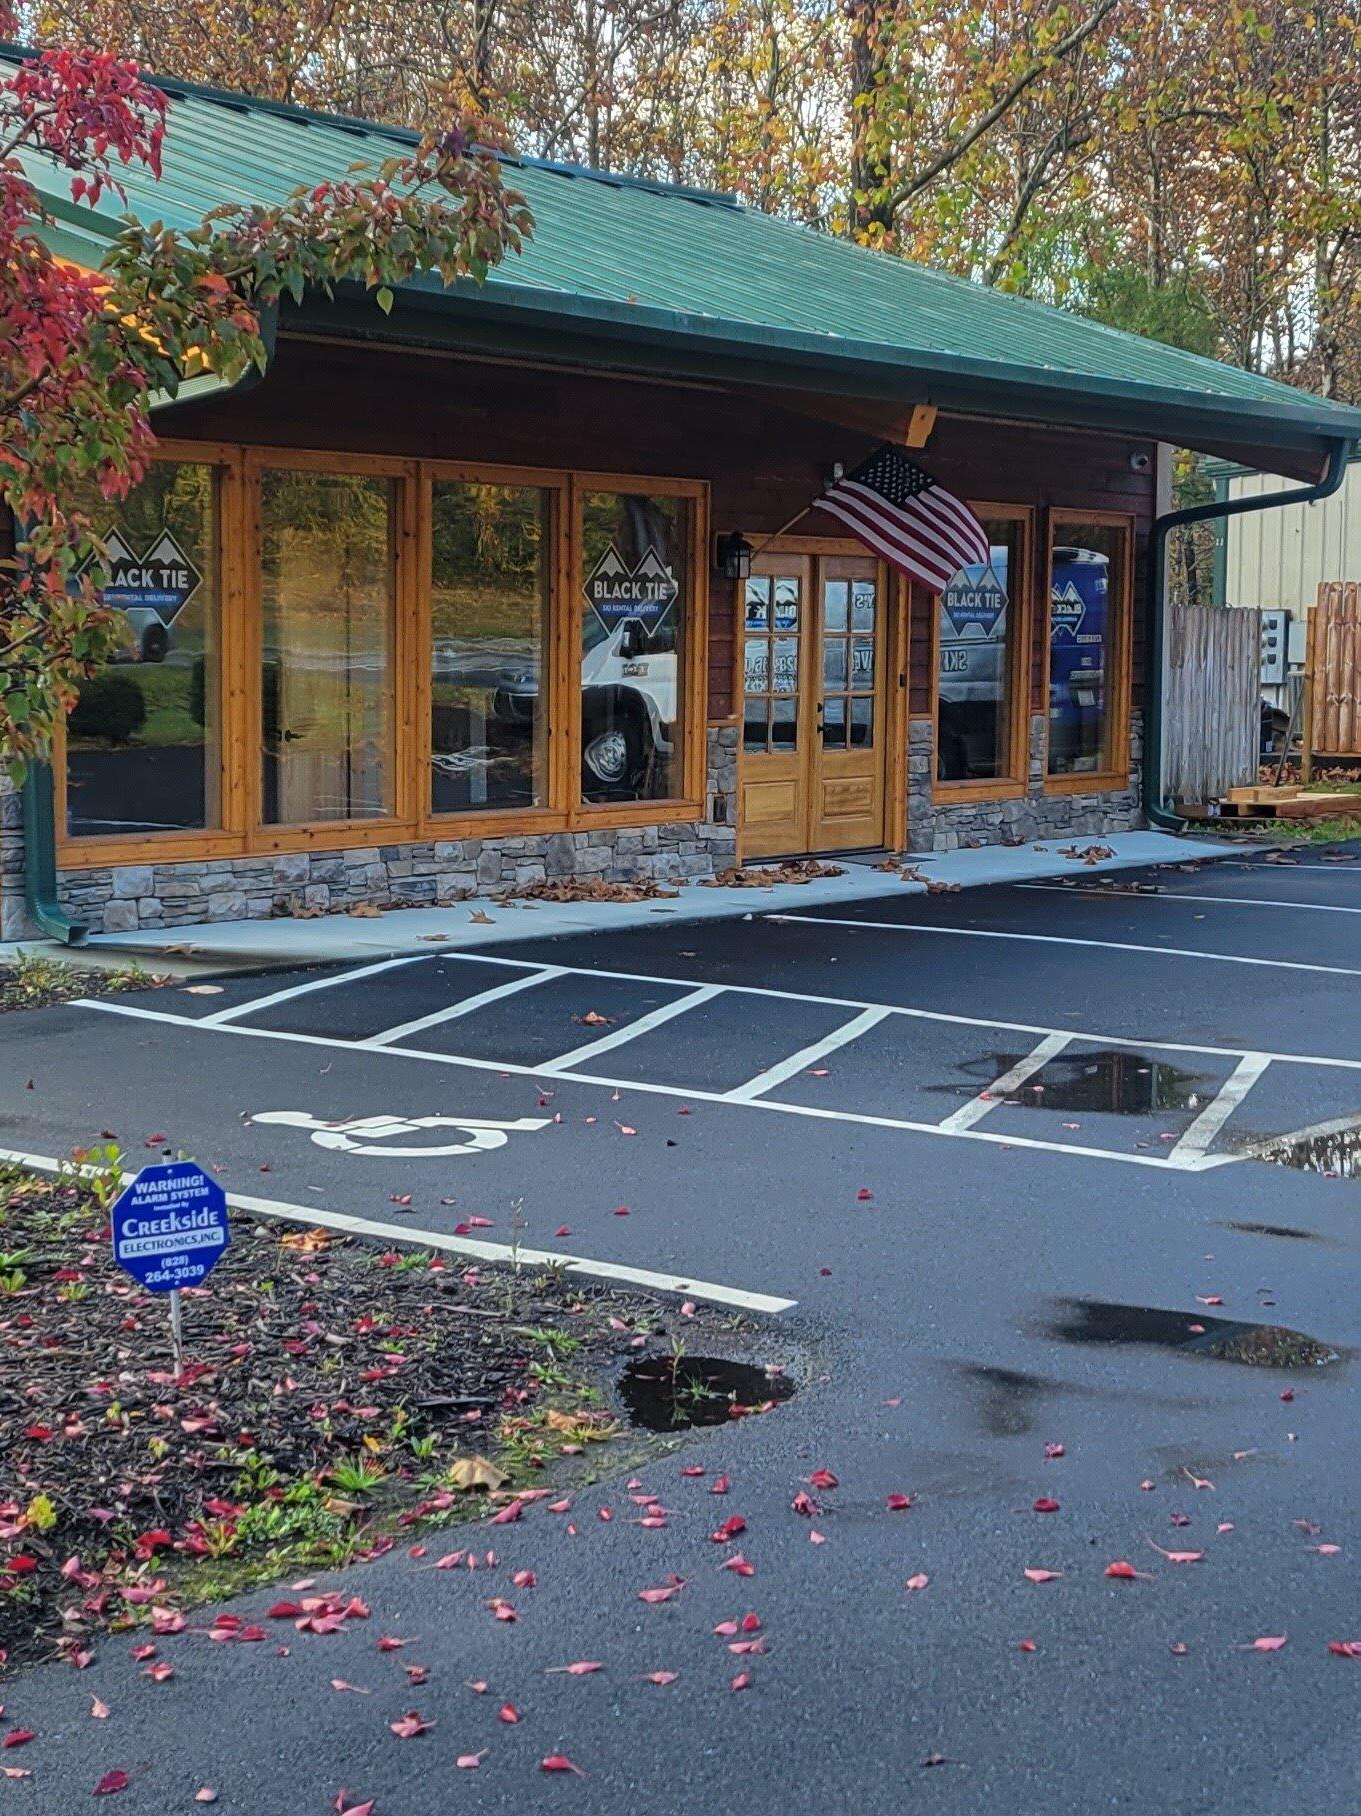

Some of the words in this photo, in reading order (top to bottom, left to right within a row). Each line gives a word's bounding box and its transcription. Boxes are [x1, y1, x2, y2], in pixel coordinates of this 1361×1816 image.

[107, 568, 155, 588] ACK
[159, 569, 190, 589] TIE
[593, 580, 642, 599] BLACK
[645, 582, 668, 600] TIE
[947, 591, 982, 608] BLACK
[984, 593, 1001, 608] TIE
[135, 1175, 205, 1194] WARNING!
[130, 1192, 169, 1206] ALARM
[170, 1187, 210, 1200] SYSTEM
[160, 1254, 189, 1269] (828)
[144, 1264, 205, 1283] 264-3039
